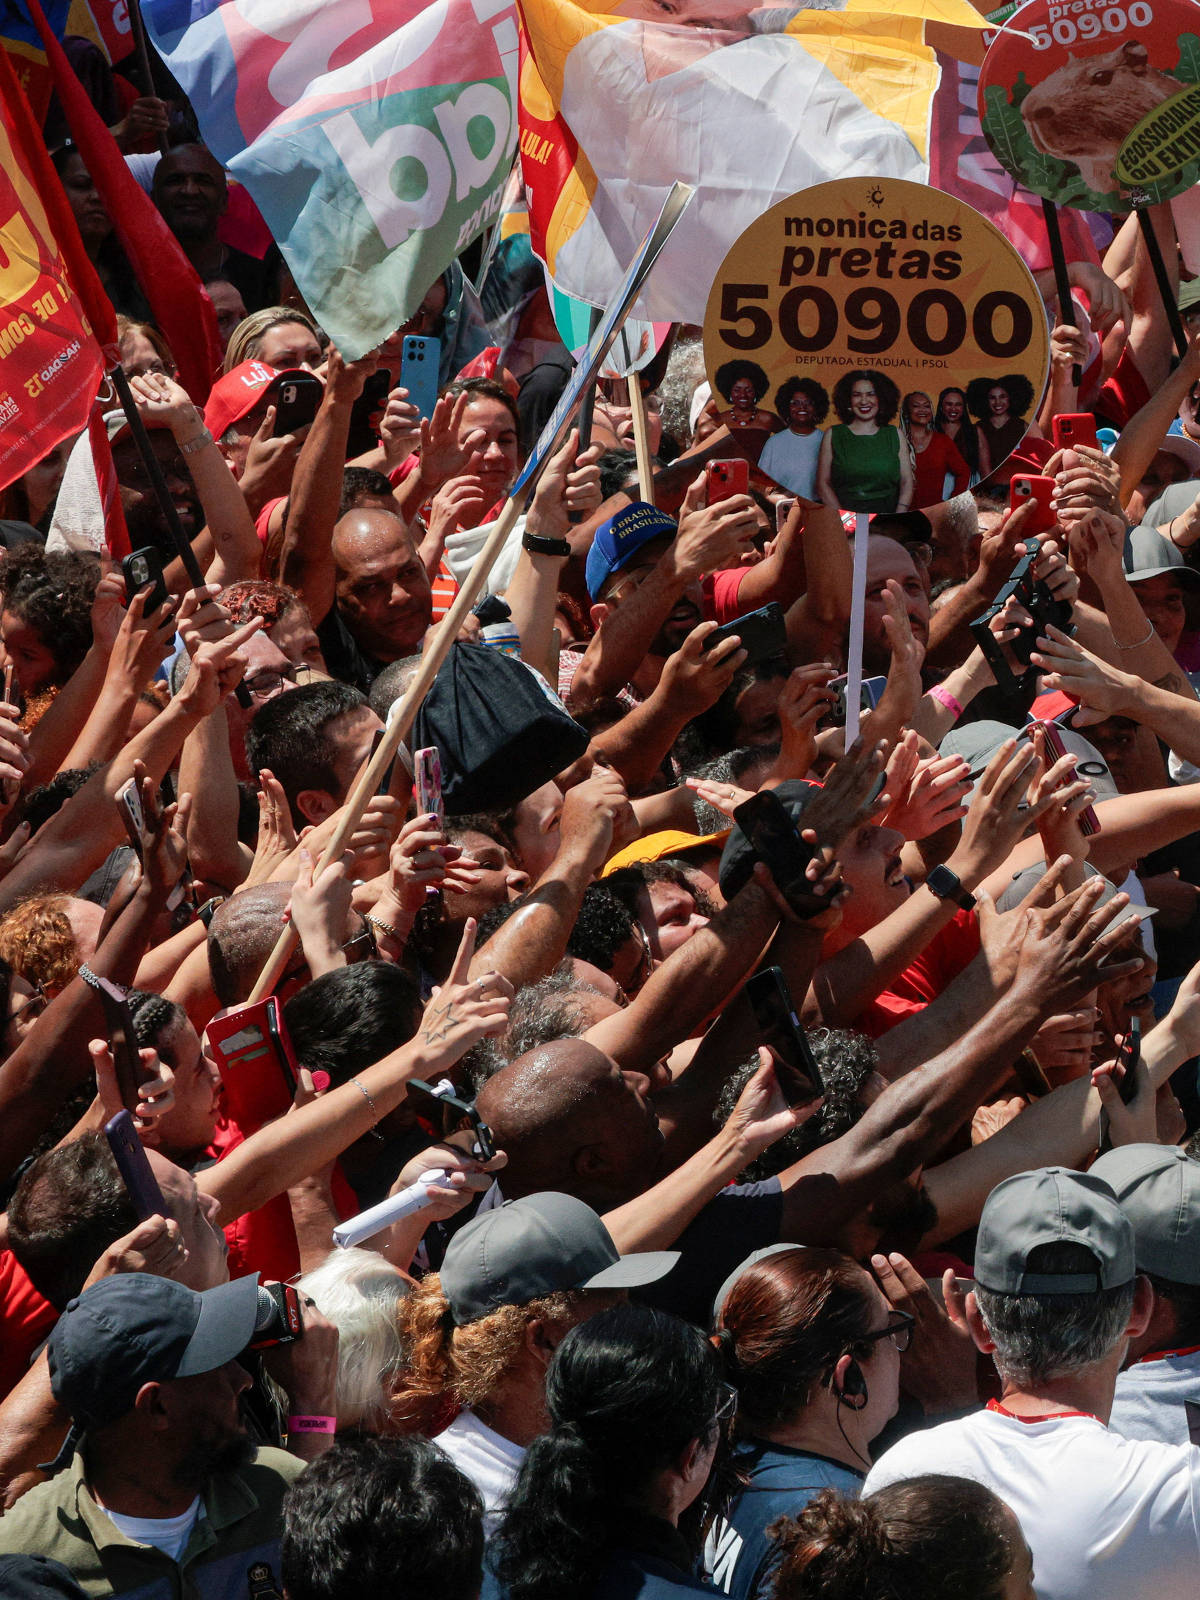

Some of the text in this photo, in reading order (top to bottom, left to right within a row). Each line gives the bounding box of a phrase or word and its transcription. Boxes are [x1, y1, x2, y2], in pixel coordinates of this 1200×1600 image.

[1028, 1, 1153, 50] 50900
[520, 128, 554, 166] LULA!
[1130, 160, 1161, 181] OU
[784, 211, 962, 242] monica das
[779, 241, 962, 286] pretas
[718, 283, 1033, 358] 50900
[240, 367, 280, 387] LUL
[795, 356, 949, 369] DEPUTADA ESTADUAL PSOL
[617, 508, 653, 529] BRASIL
